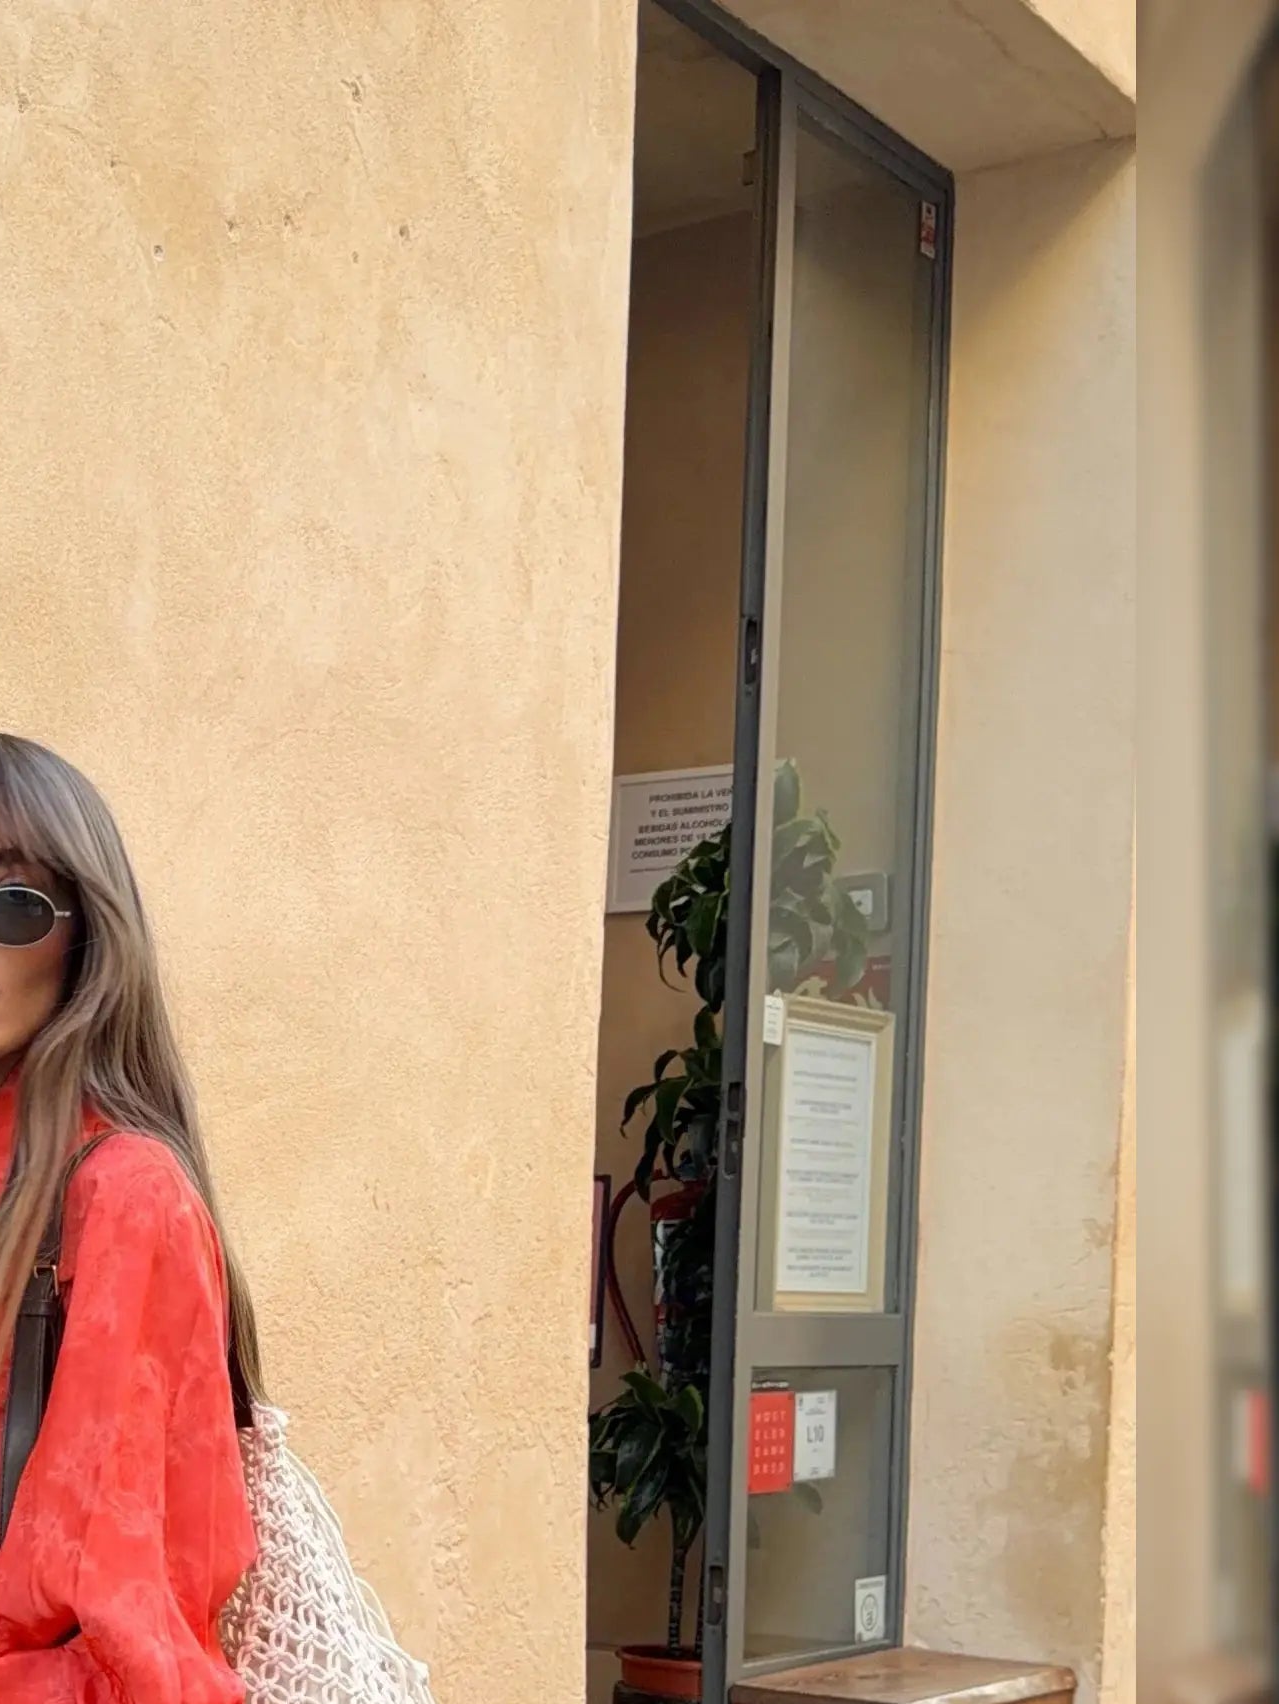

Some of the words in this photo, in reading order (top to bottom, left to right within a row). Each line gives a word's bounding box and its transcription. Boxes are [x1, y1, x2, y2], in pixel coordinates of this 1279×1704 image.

[649, 792, 698, 802] PROHIBIDA
[701, 789, 713, 799] LA
[715, 788, 732, 797] VEN
[672, 803, 729, 817] SUMINISTRO
[638, 823, 677, 834] BEBIDAS
[634, 835, 678, 846] MENORES
[681, 833, 693, 843] DE
[631, 848, 677, 860] CONSUMO
